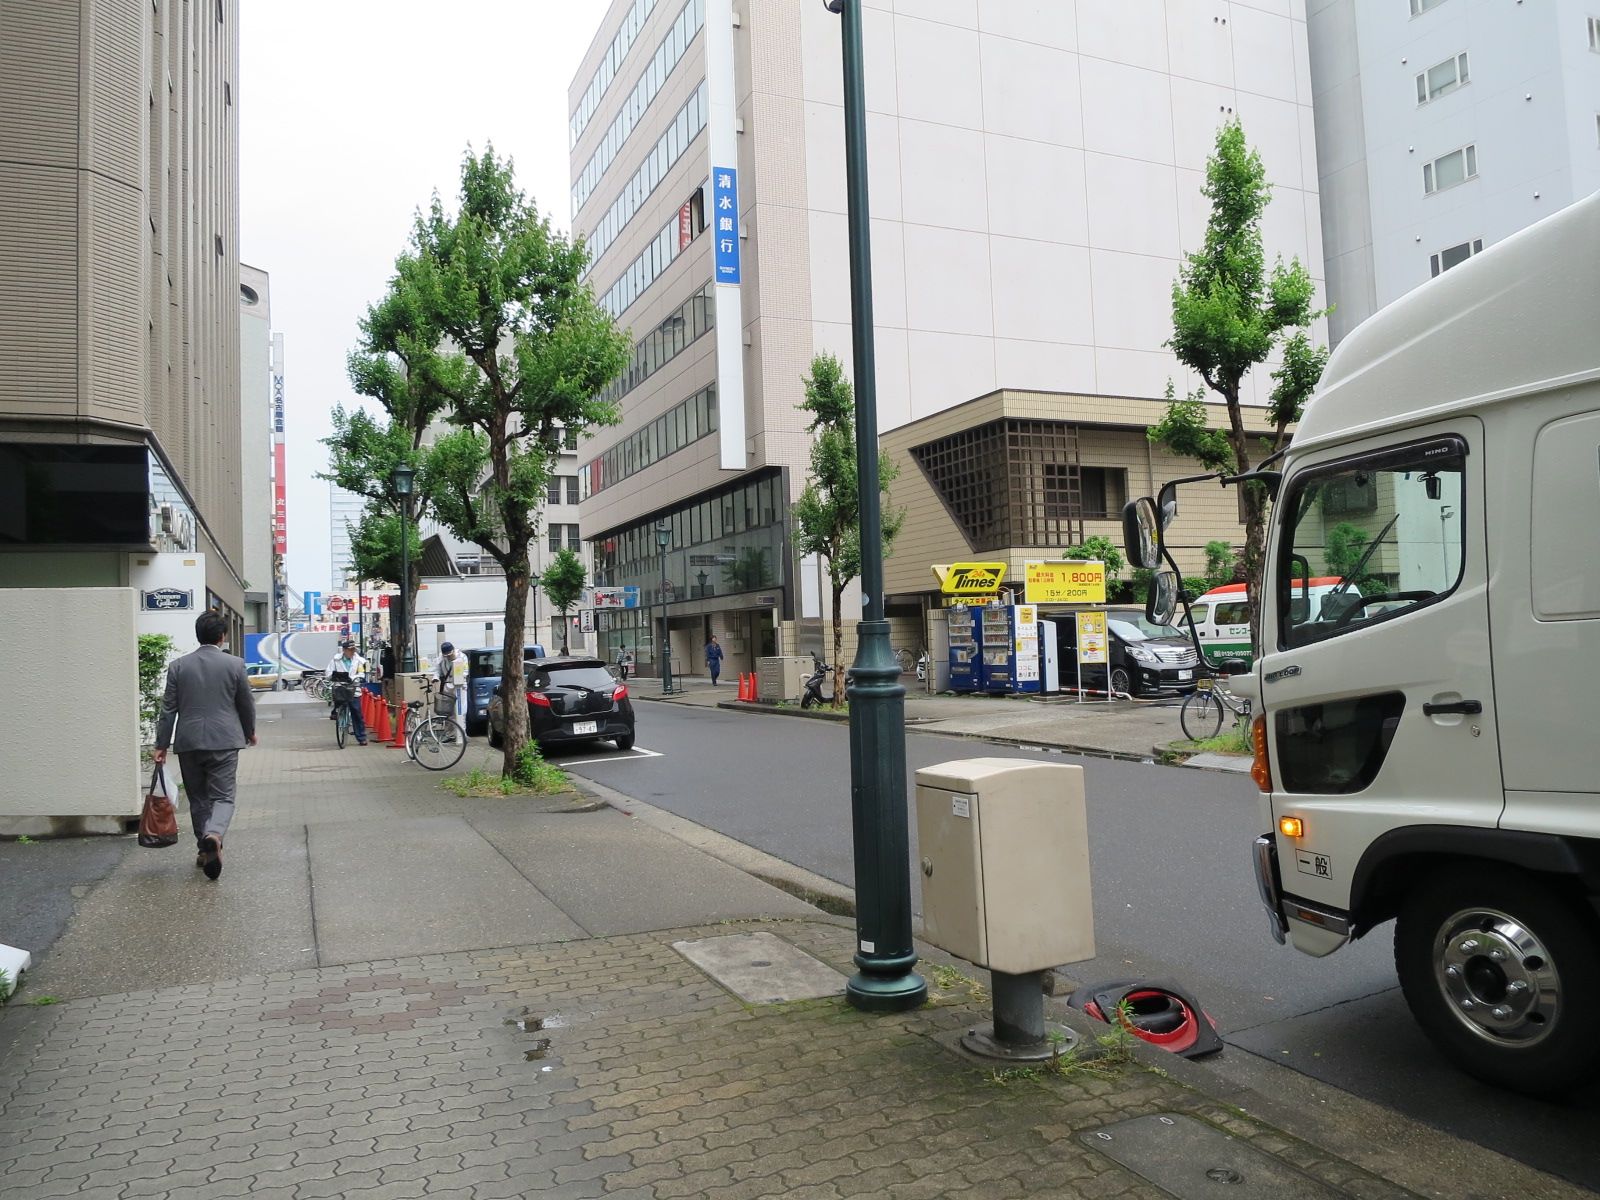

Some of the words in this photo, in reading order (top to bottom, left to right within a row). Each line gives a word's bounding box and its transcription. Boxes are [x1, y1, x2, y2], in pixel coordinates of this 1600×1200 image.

[719, 174, 733, 253] 清水銀行
[1425, 447, 1448, 456] HINO
[954, 574, 996, 589] Times
[1062, 572, 1102, 583] 1,800円
[1299, 856, 1329, 876] 一般
